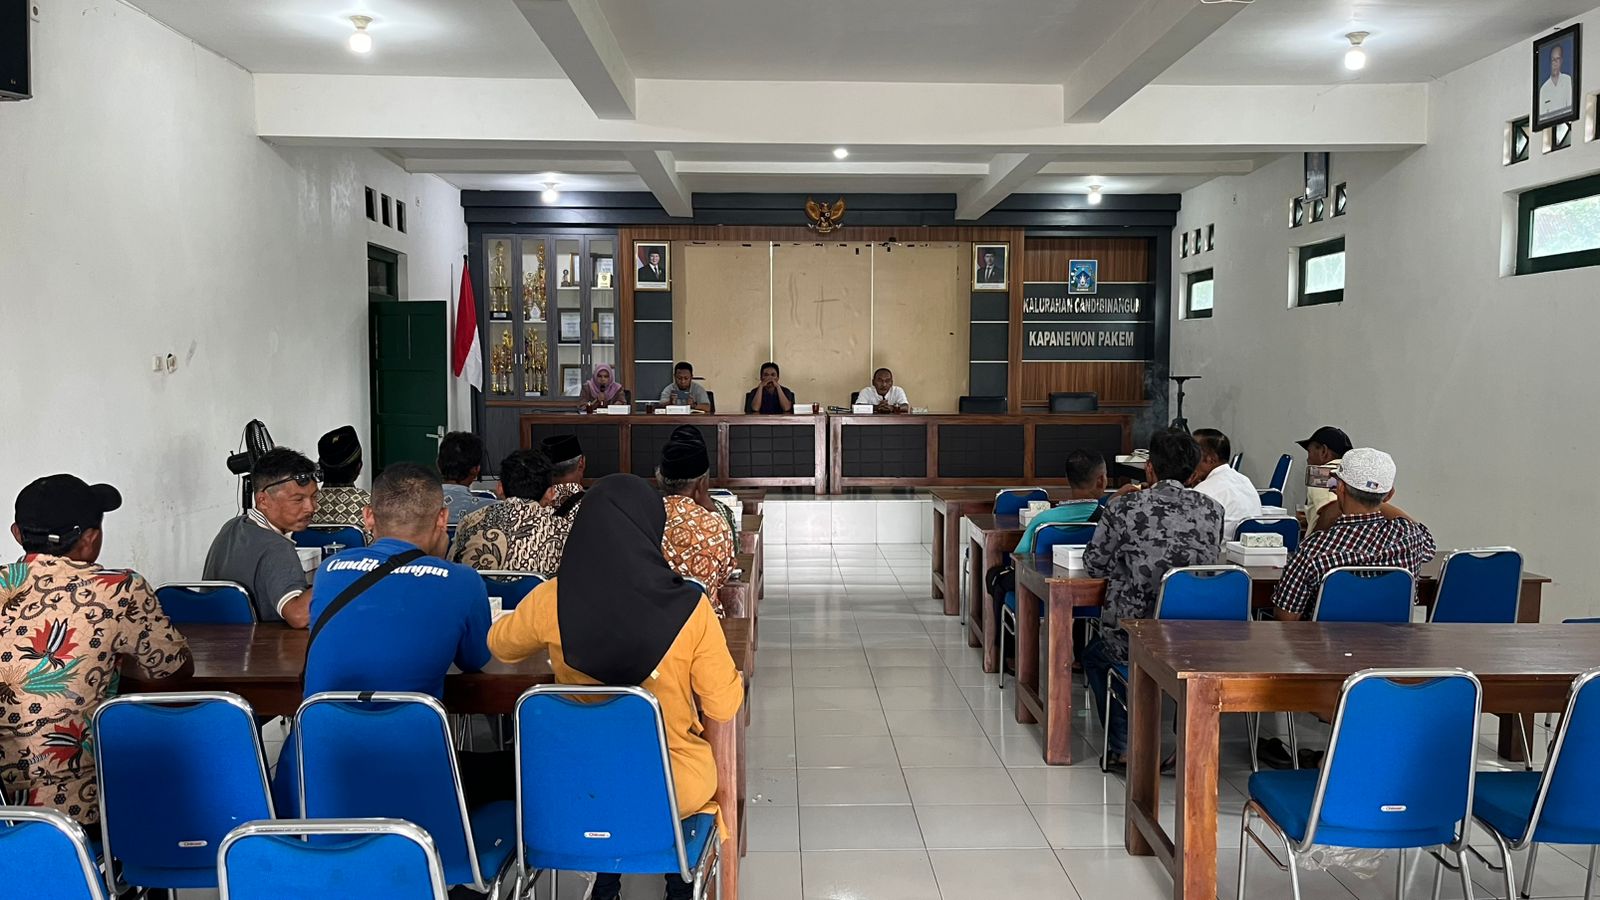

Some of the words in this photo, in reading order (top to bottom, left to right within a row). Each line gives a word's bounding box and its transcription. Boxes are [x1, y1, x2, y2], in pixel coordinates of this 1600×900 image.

[1023, 297, 1073, 313] KALURAHAN
[1029, 331, 1094, 346] KAPANEWON
[1098, 331, 1134, 346] PAKEM
